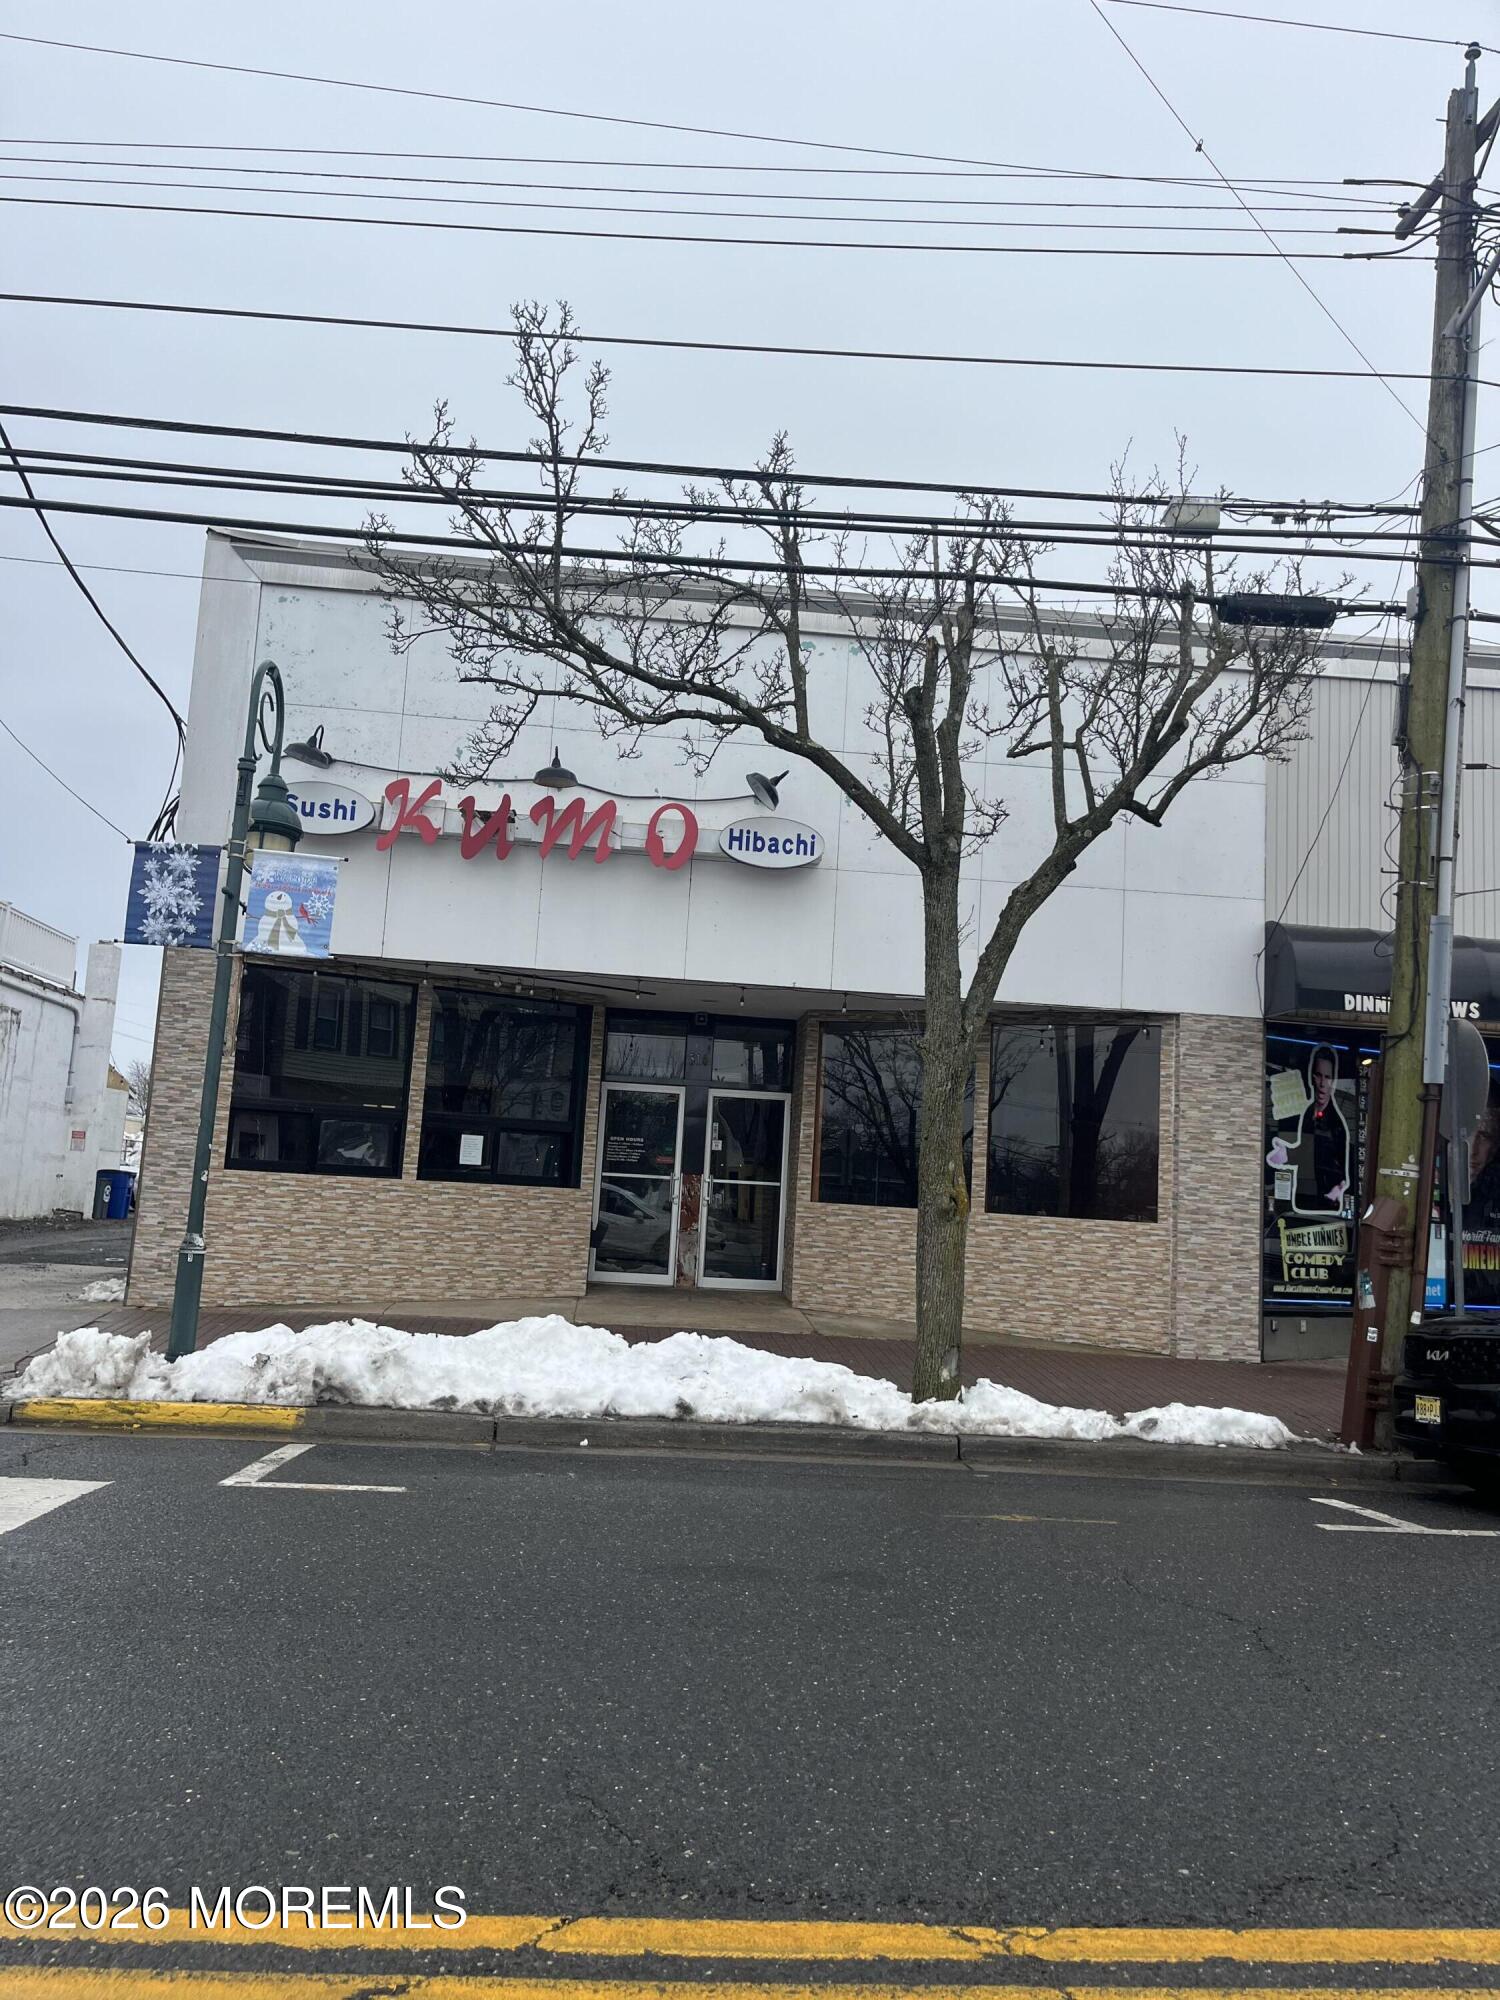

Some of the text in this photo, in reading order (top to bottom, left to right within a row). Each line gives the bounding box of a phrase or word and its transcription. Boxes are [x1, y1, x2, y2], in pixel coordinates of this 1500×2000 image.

[286, 793, 357, 821] Sushi
[728, 828, 816, 857] Hibachi
[1344, 993, 1481, 1019] DINN WS
[1284, 1252, 1346, 1266] COMEDY
[1291, 1267, 1329, 1280] CLUB
[1426, 1349, 1449, 1360] KIA
